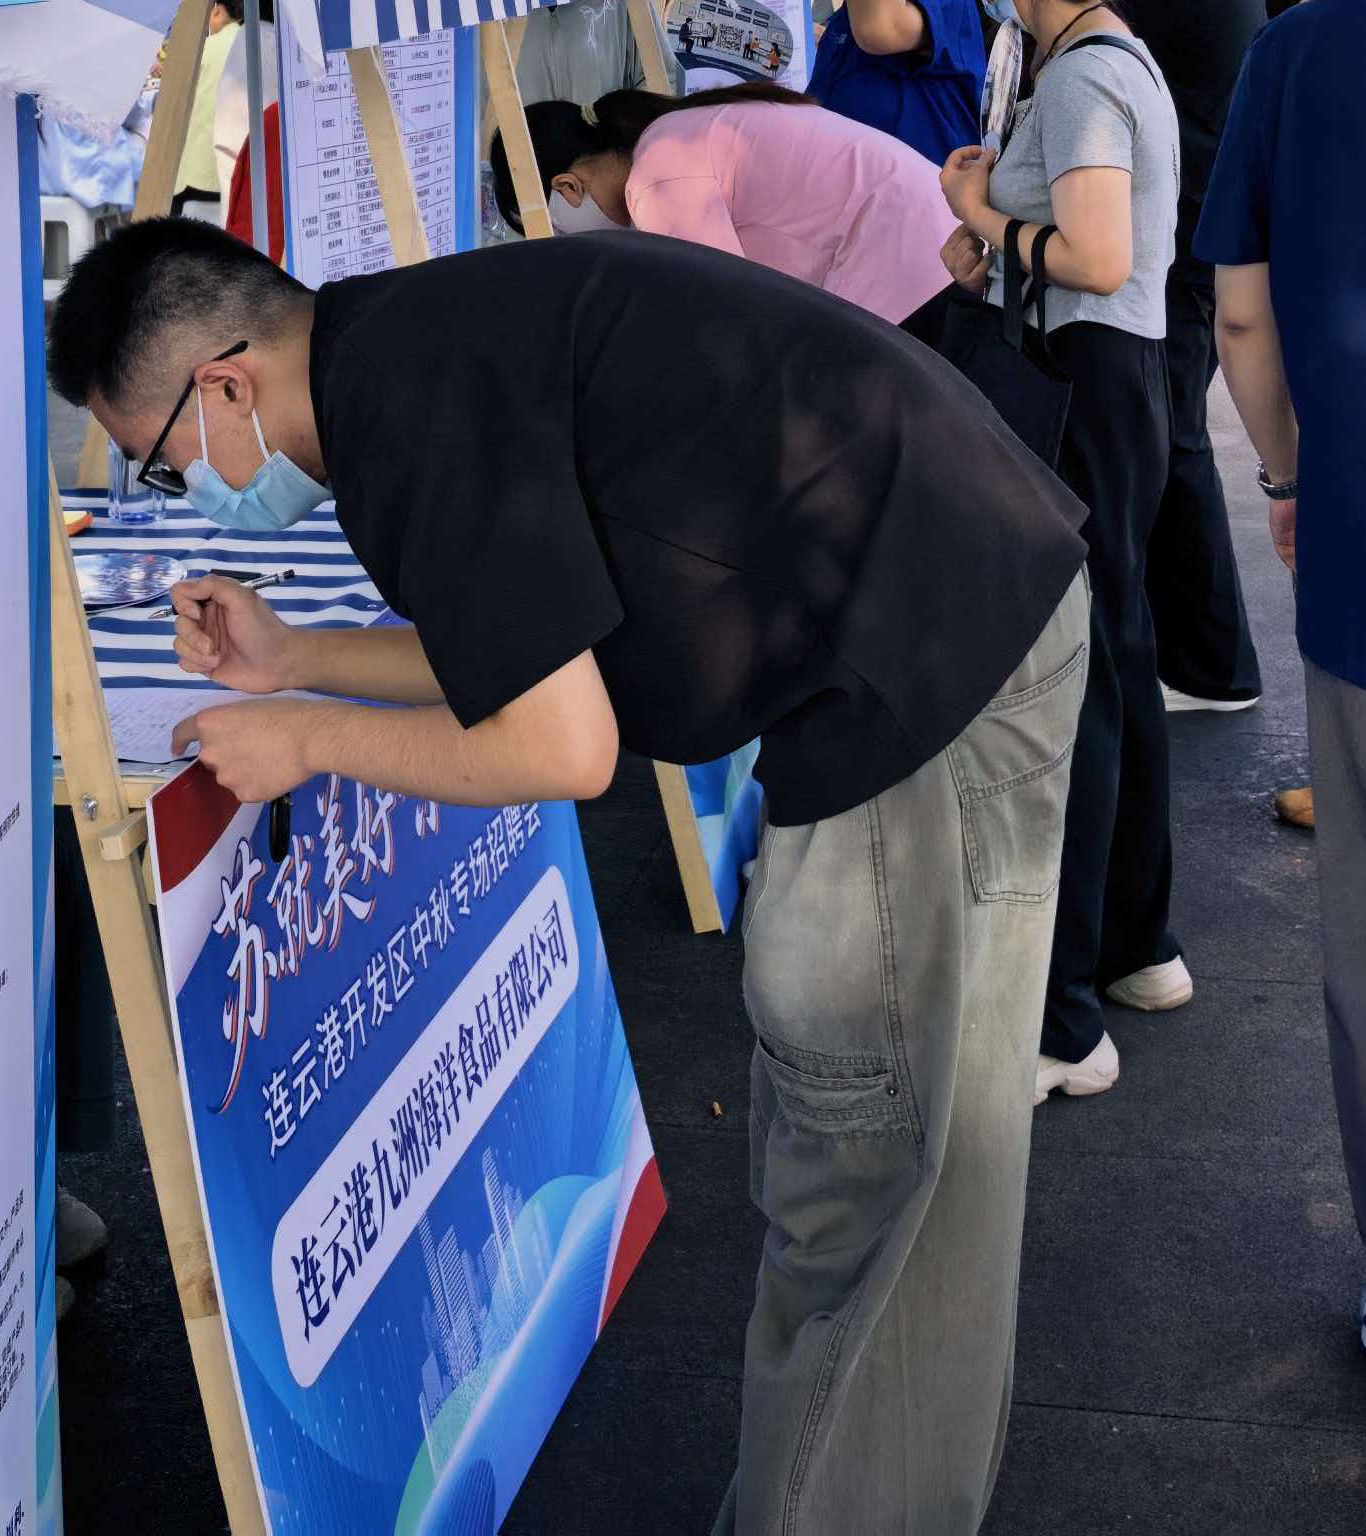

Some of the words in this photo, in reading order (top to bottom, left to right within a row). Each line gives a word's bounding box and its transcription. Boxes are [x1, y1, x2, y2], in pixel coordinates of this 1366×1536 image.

[290, 898, 568, 1344] 连云港九洲海洋食品有限公司
